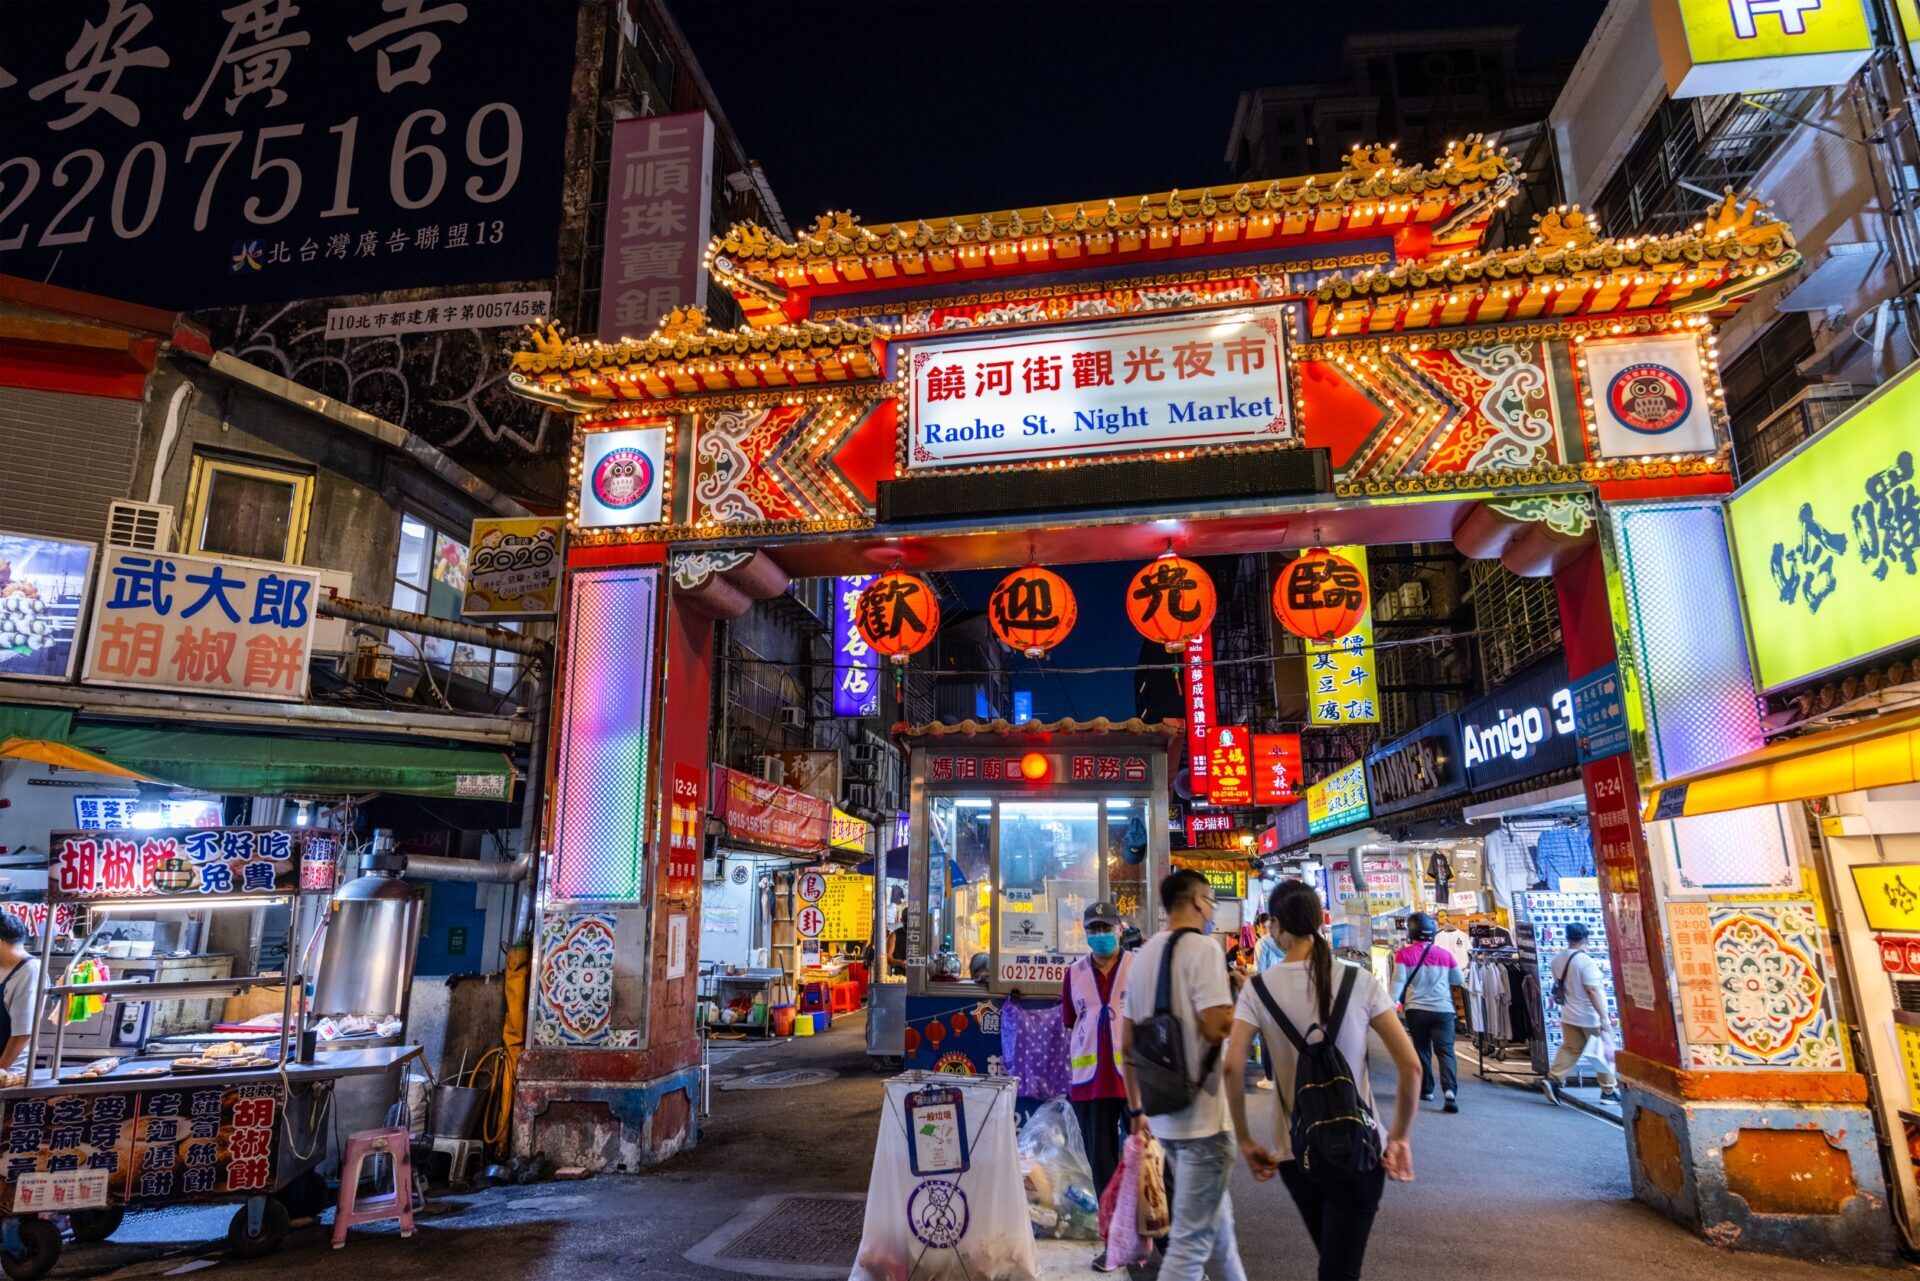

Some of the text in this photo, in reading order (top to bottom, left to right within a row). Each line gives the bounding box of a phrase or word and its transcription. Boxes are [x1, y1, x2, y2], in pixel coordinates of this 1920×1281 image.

[926, 336, 1267, 403] 饒河街觀光夜市
[924, 395, 1275, 446] Raohe St. Night Market
[472, 545, 554, 576] 2020
[106, 556, 311, 629] 武大郎
[855, 578, 928, 644] 歡
[992, 576, 1060, 638] 迎
[1288, 560, 1364, 611] 臨
[97, 617, 303, 691] 胡椒餅
[1211, 748, 1246, 764] 三媽
[1463, 706, 1544, 769] Amigo
[1072, 756, 1148, 781] 服務台
[185, 831, 291, 861] 不好吃
[1192, 817, 1231, 831] 金瑞利
[59, 838, 179, 893] 胡椒餅
[200, 863, 276, 893] 免費
[1675, 919, 1708, 930] 24:00
[1676, 932, 1696, 976] 自行車
[1687, 978, 1721, 1040] 禁止進入
[228, 1098, 276, 1191] 胡椒餅
